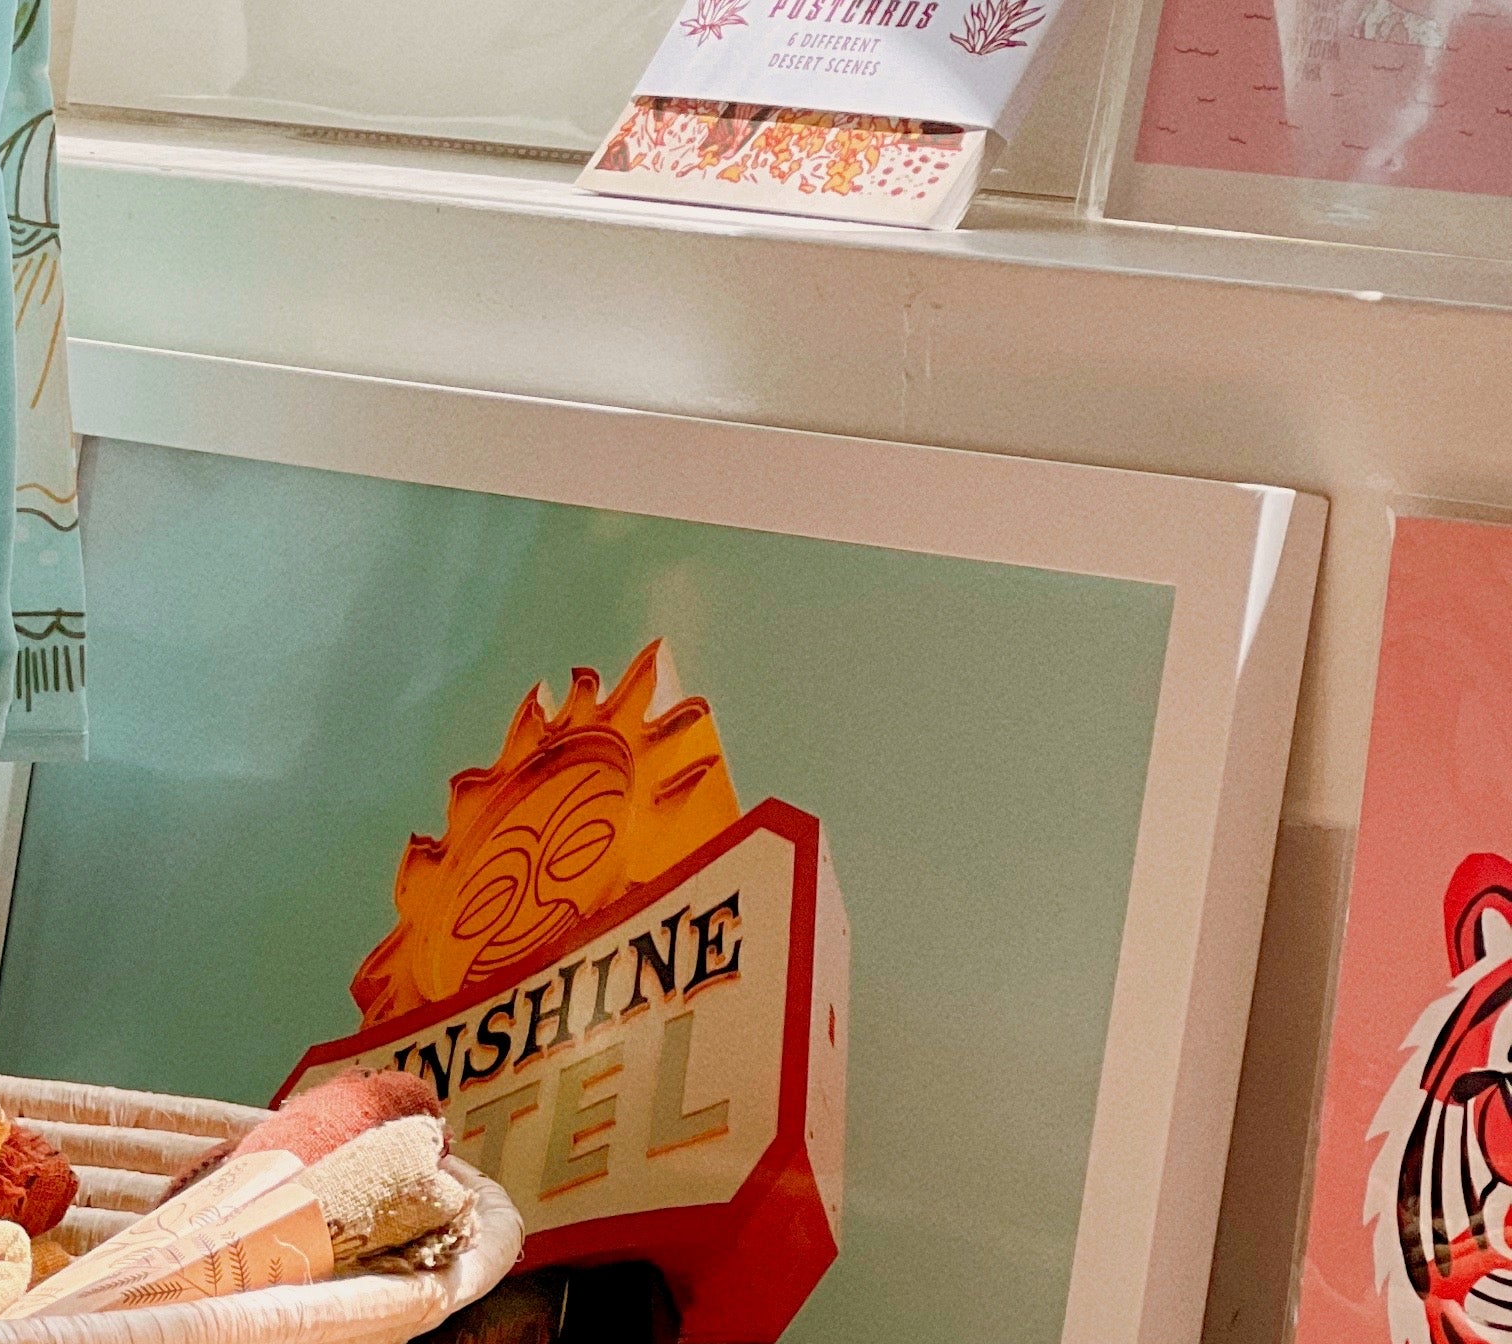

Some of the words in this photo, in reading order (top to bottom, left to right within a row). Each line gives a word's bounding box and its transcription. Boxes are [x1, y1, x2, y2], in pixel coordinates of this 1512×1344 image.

[767, 53, 824, 71] DESERT
[825, 58, 881, 77] SCENES
[786, 32, 797, 48] 6
[801, 34, 881, 54] DIFFERENT
[393, 888, 744, 1102] NSHINE
[460, 1010, 730, 1202] TEL
